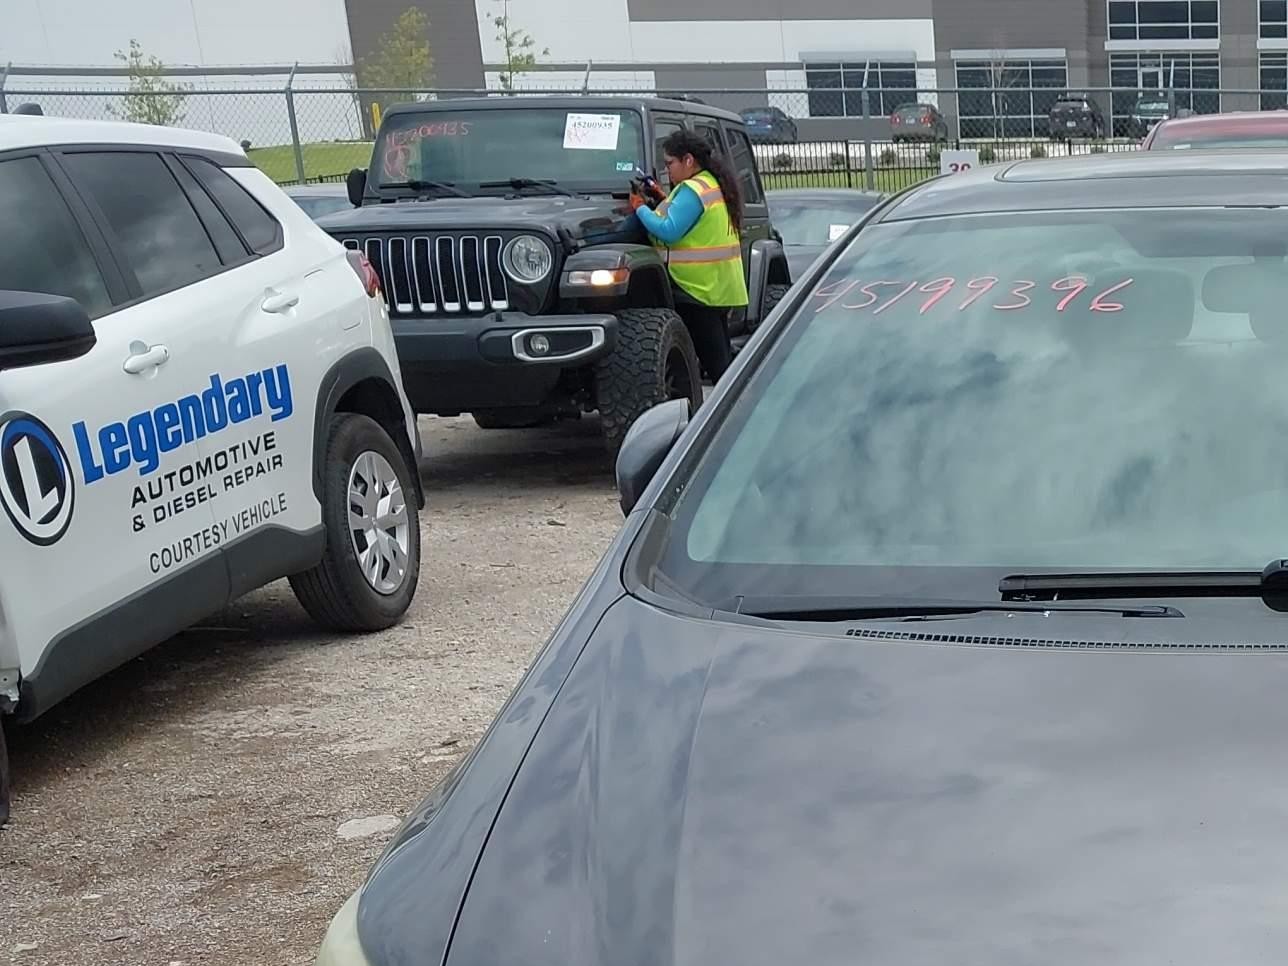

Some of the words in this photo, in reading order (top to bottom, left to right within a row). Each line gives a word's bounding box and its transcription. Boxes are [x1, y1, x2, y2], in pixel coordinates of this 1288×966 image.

[815, 277, 1133, 314] 45199396
[72, 363, 294, 485] Legendary
[130, 431, 277, 508] AUTOMOTIVE
[132, 514, 146, 532] &
[153, 484, 217, 523] DIESEL
[223, 454, 283, 491] REPAIR
[149, 519, 229, 574] COURTESY
[231, 493, 288, 534] VEHICLE
